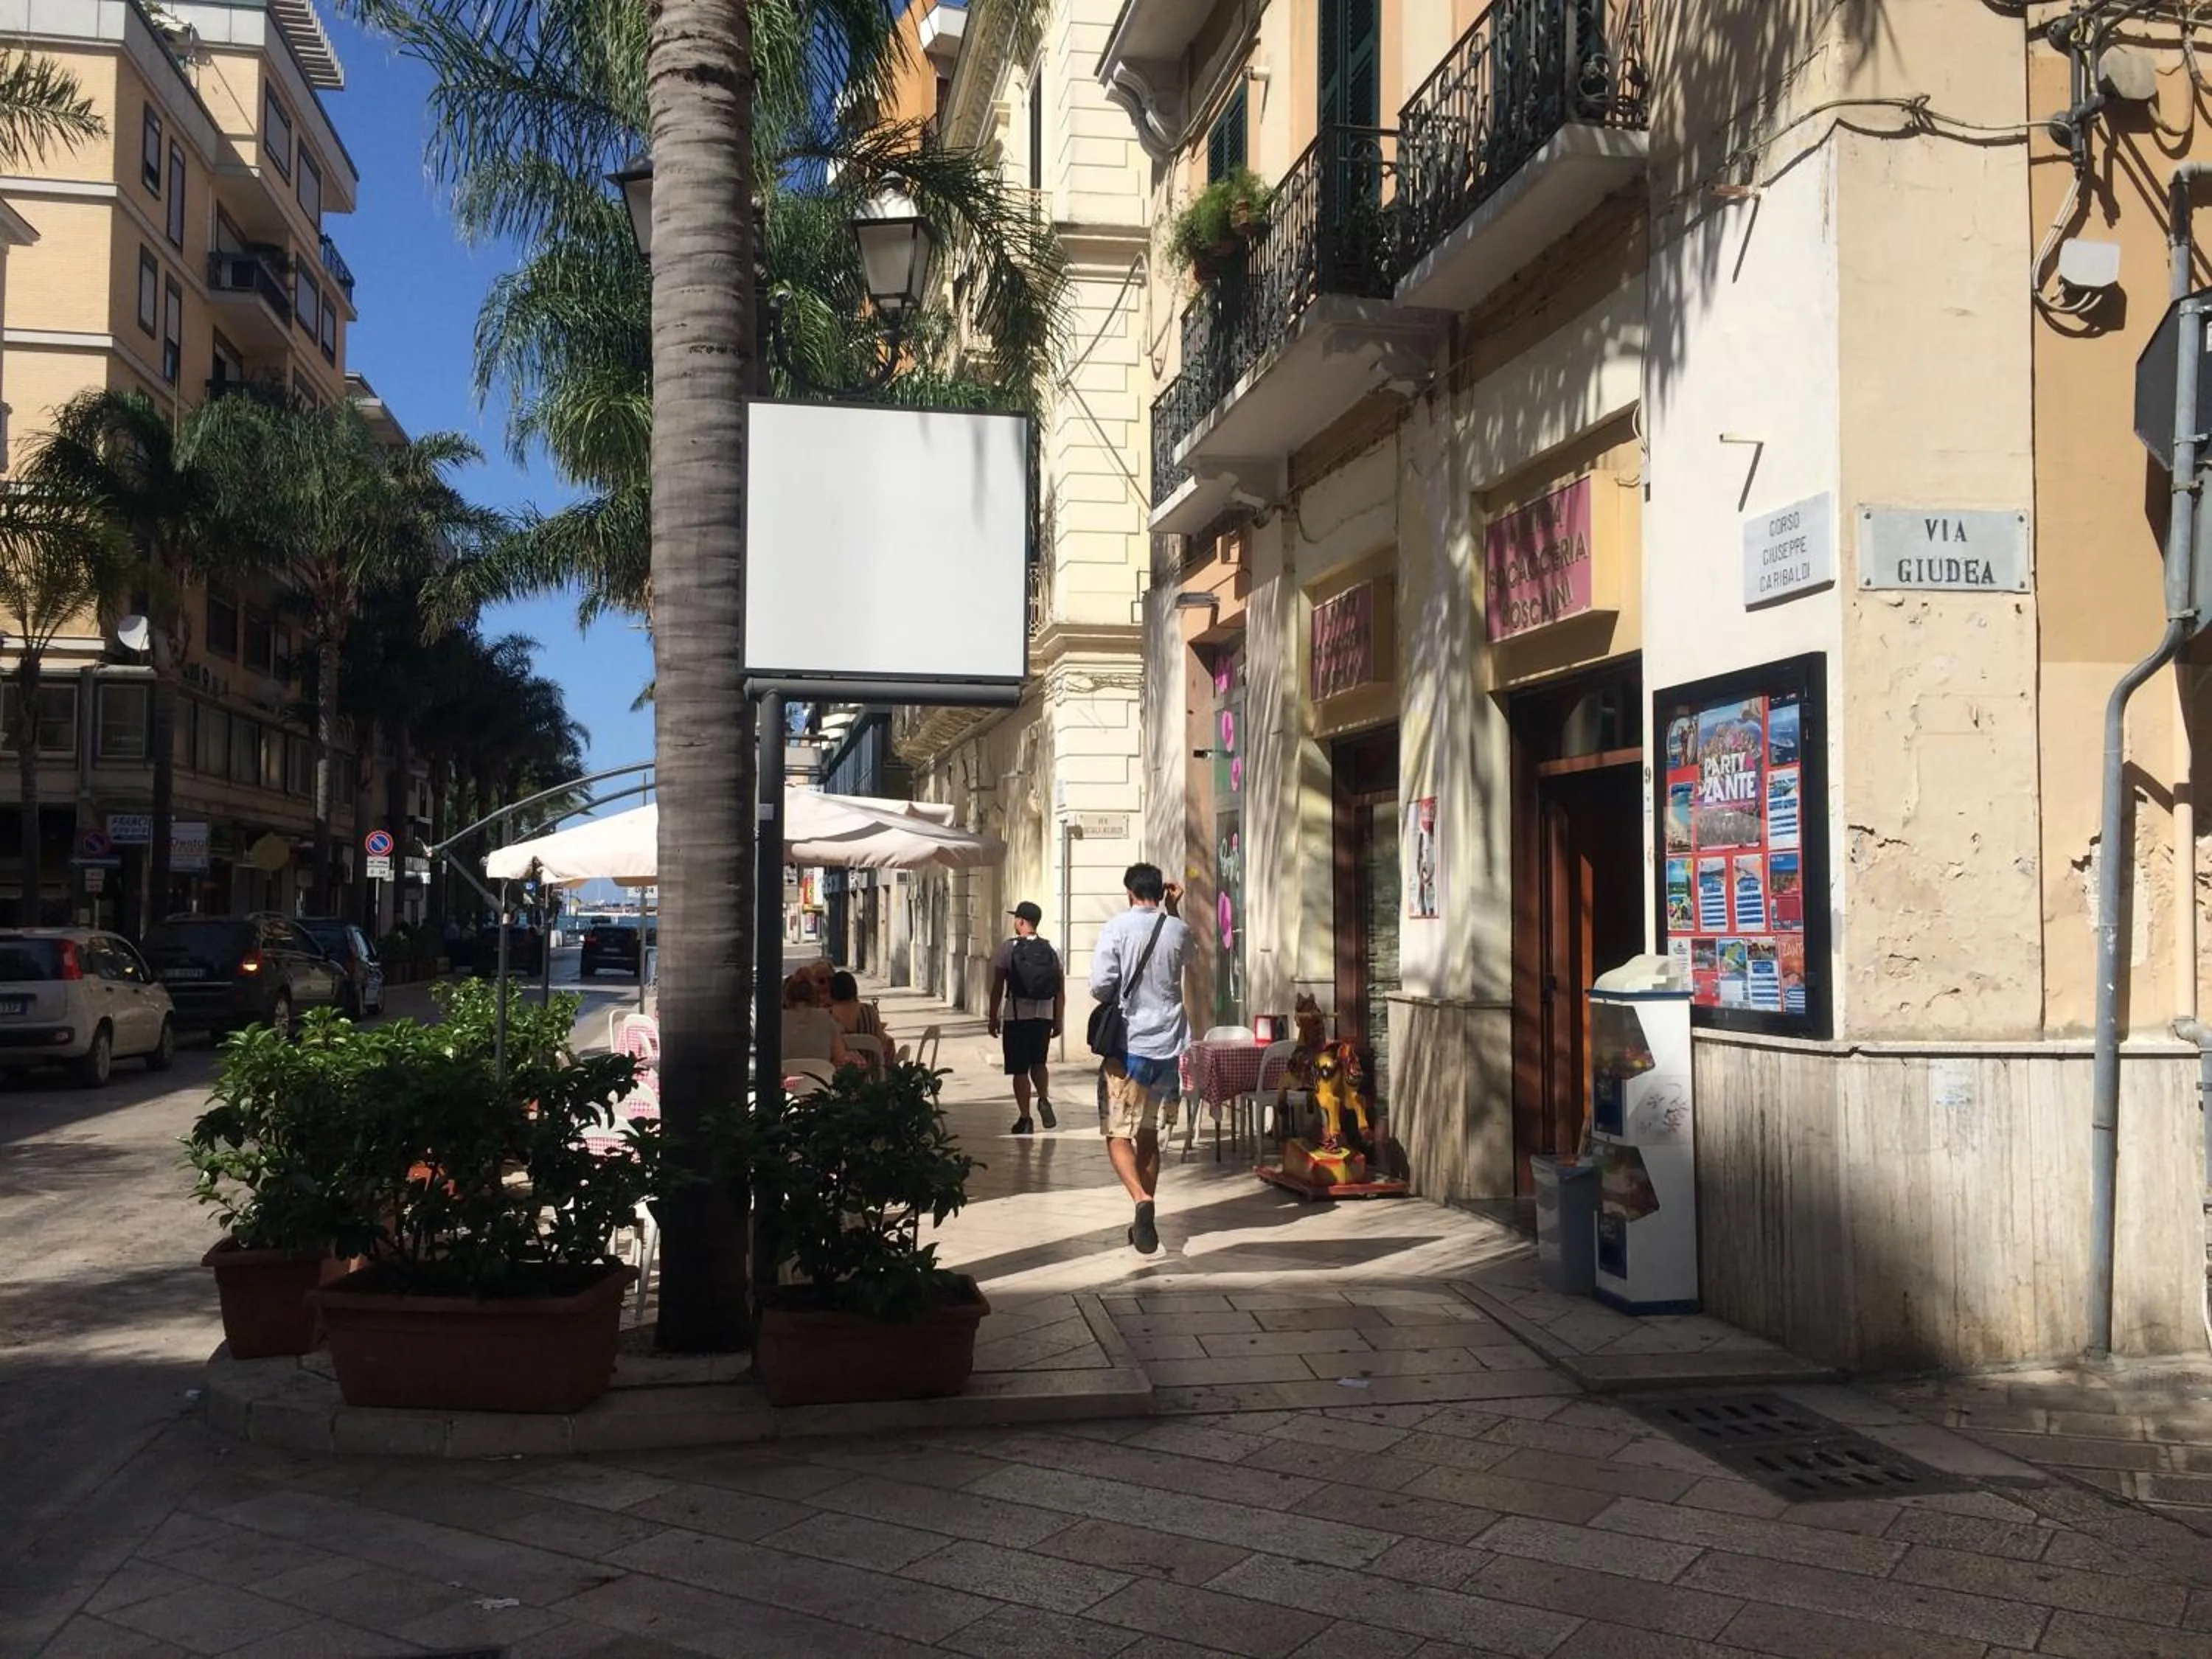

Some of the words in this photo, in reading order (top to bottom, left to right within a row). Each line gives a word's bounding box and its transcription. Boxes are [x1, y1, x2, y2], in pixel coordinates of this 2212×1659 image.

[1769, 511, 1801, 537] CORSO
[1924, 518, 1968, 543] VIA
[1762, 535, 1807, 566] GIUSEPPE
[1759, 563, 1810, 594] GARIBALDI
[1897, 557, 1997, 585] GIUDEA
[1704, 752, 1747, 776] PARTY
[1703, 771, 1757, 803] ZANTE
